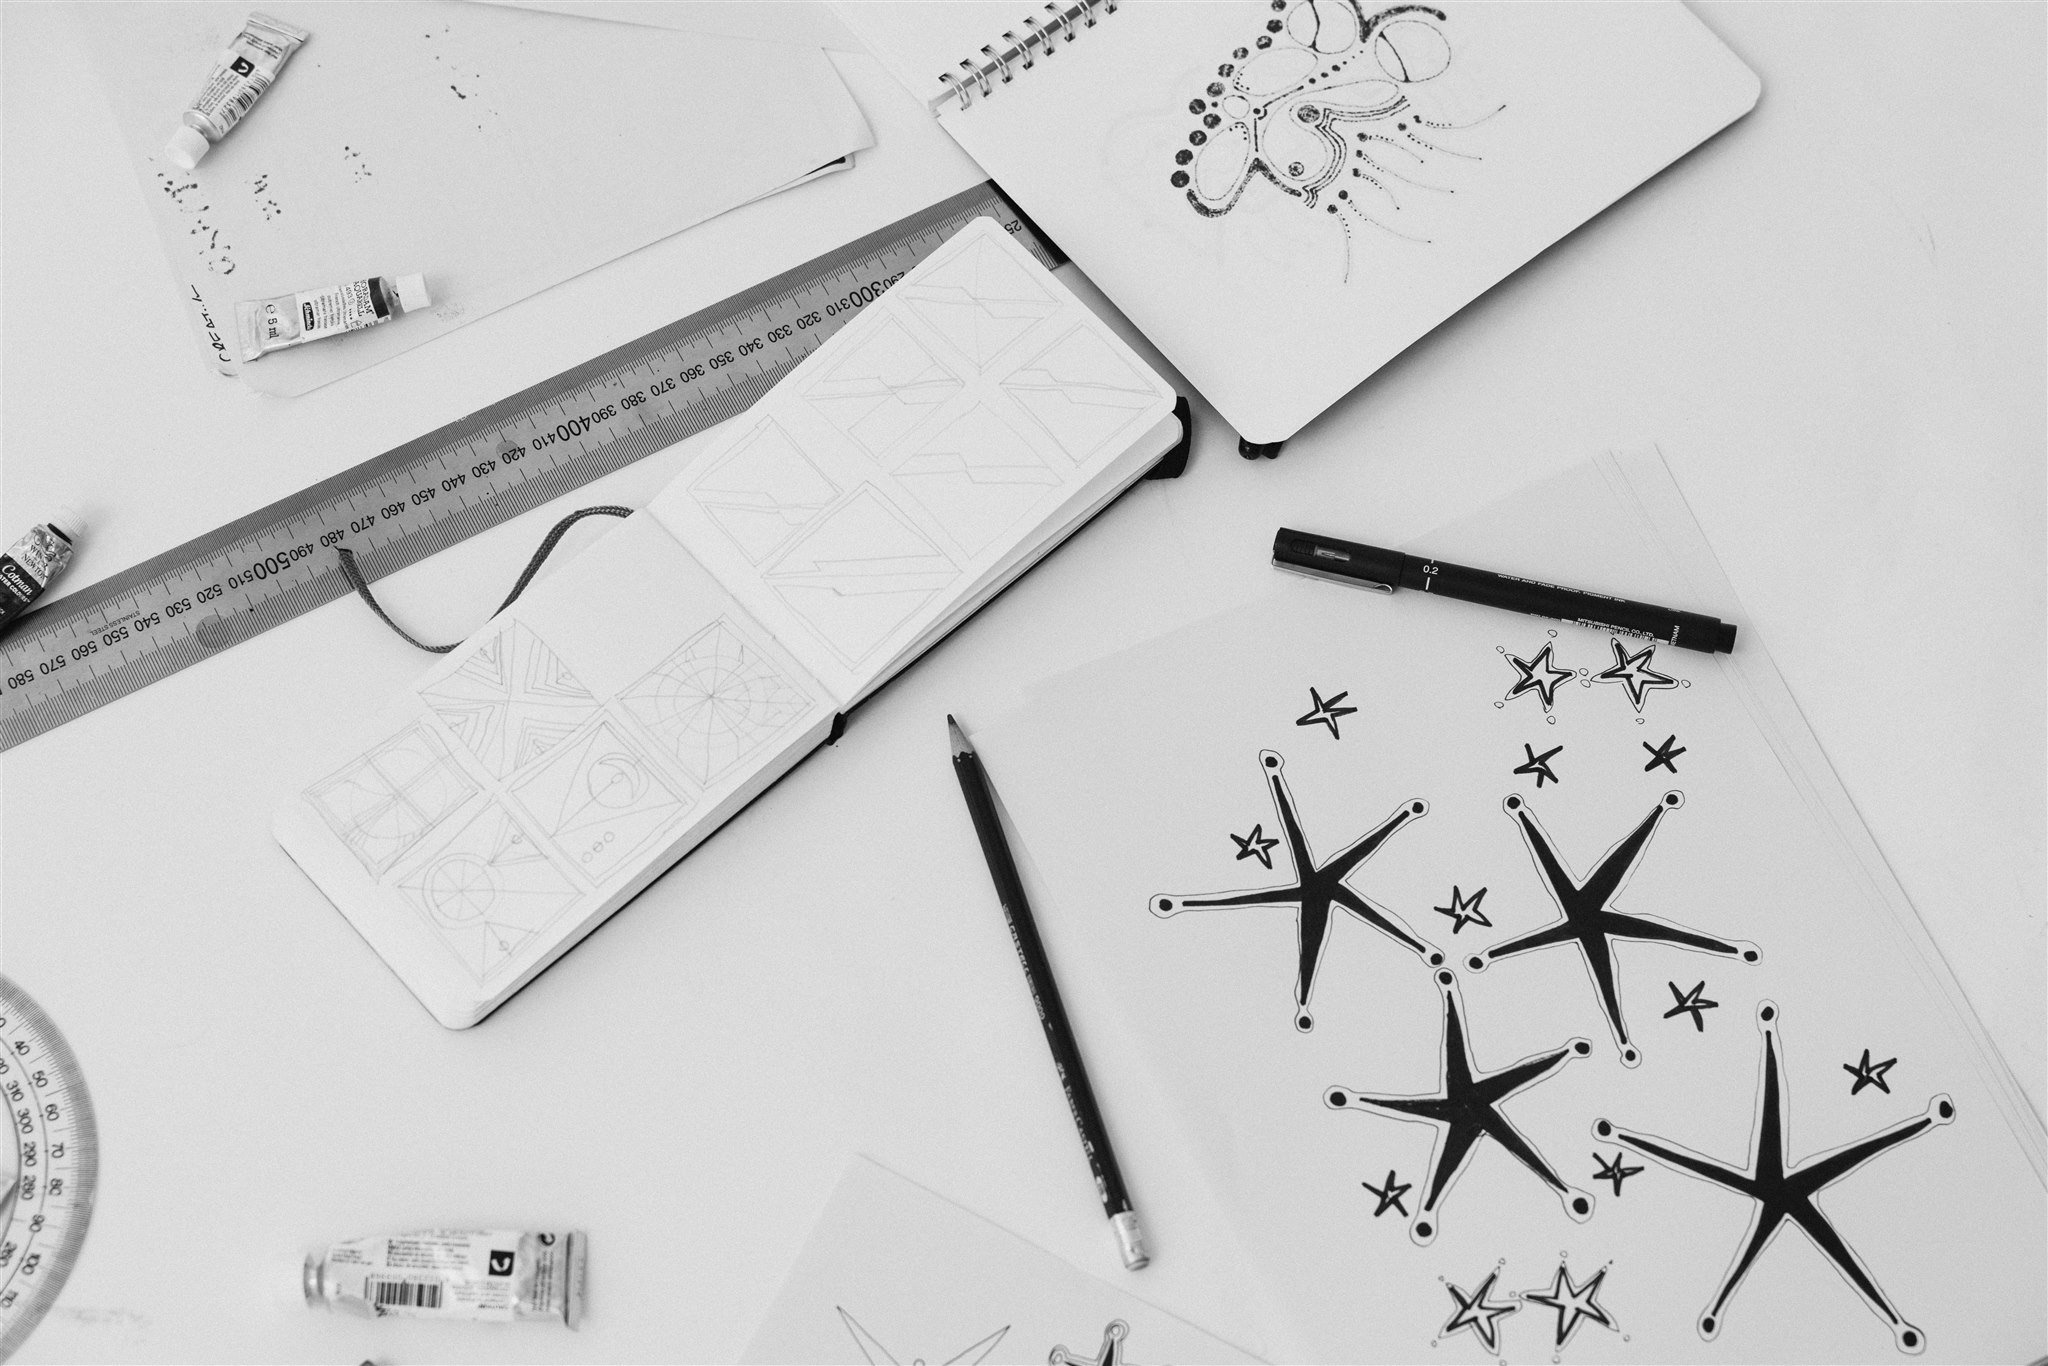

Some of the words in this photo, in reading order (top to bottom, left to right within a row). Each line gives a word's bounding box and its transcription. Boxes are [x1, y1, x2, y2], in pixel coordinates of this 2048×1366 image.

[848, 280, 885, 308] 300
[826, 298, 850, 316] 310
[266, 317, 278, 325] 5
[797, 311, 821, 329] 320
[267, 326, 280, 339] ml
[768, 325, 792, 343] 330
[738, 338, 763, 356] 340
[709, 351, 734, 369] 350
[680, 364, 705, 383] 360
[650, 378, 676, 396] 370
[621, 391, 646, 410] 380
[591, 405, 616, 423] 390
[556, 416, 590, 441] 400
[532, 433, 555, 450] 410
[502, 447, 525, 464] 420
[472, 460, 495, 478] 430
[442, 474, 465, 491] 440
[411, 488, 435, 505] 450
[381, 502, 405, 519] 460
[351, 516, 375, 533] 470
[320, 530, 344, 547] 480
[289, 543, 313, 561] 490
[253, 552, 291, 580] 500
[1423, 564, 1439, 576] 0.2
[0, 573, 12, 588] ATER
[2, 564, 34, 595] Cotman
[228, 570, 254, 589] 510
[1498, 574, 1521, 582] WATER
[197, 584, 223, 603] 520
[166, 598, 192, 617] 530
[107, 609, 141, 628] STAINLESS
[134, 612, 160, 632] 540
[1577, 617, 1611, 629] MITSUBISHI
[1611, 624, 1630, 633] PENCIL
[88, 624, 109, 636] STEEL
[103, 627, 129, 646] 550
[71, 641, 98, 660] 560
[40, 655, 66, 675] 570
[8, 670, 34, 689] 580
[14, 1040, 31, 1056] 40
[32, 1070, 49, 1088] 50
[6, 1080, 25, 1102] 310
[17, 1107, 34, 1135] 300
[45, 1103, 60, 1122] 60
[24, 1141, 37, 1168] 290
[51, 1142, 65, 1159] 70
[50, 1178, 63, 1197] 80
